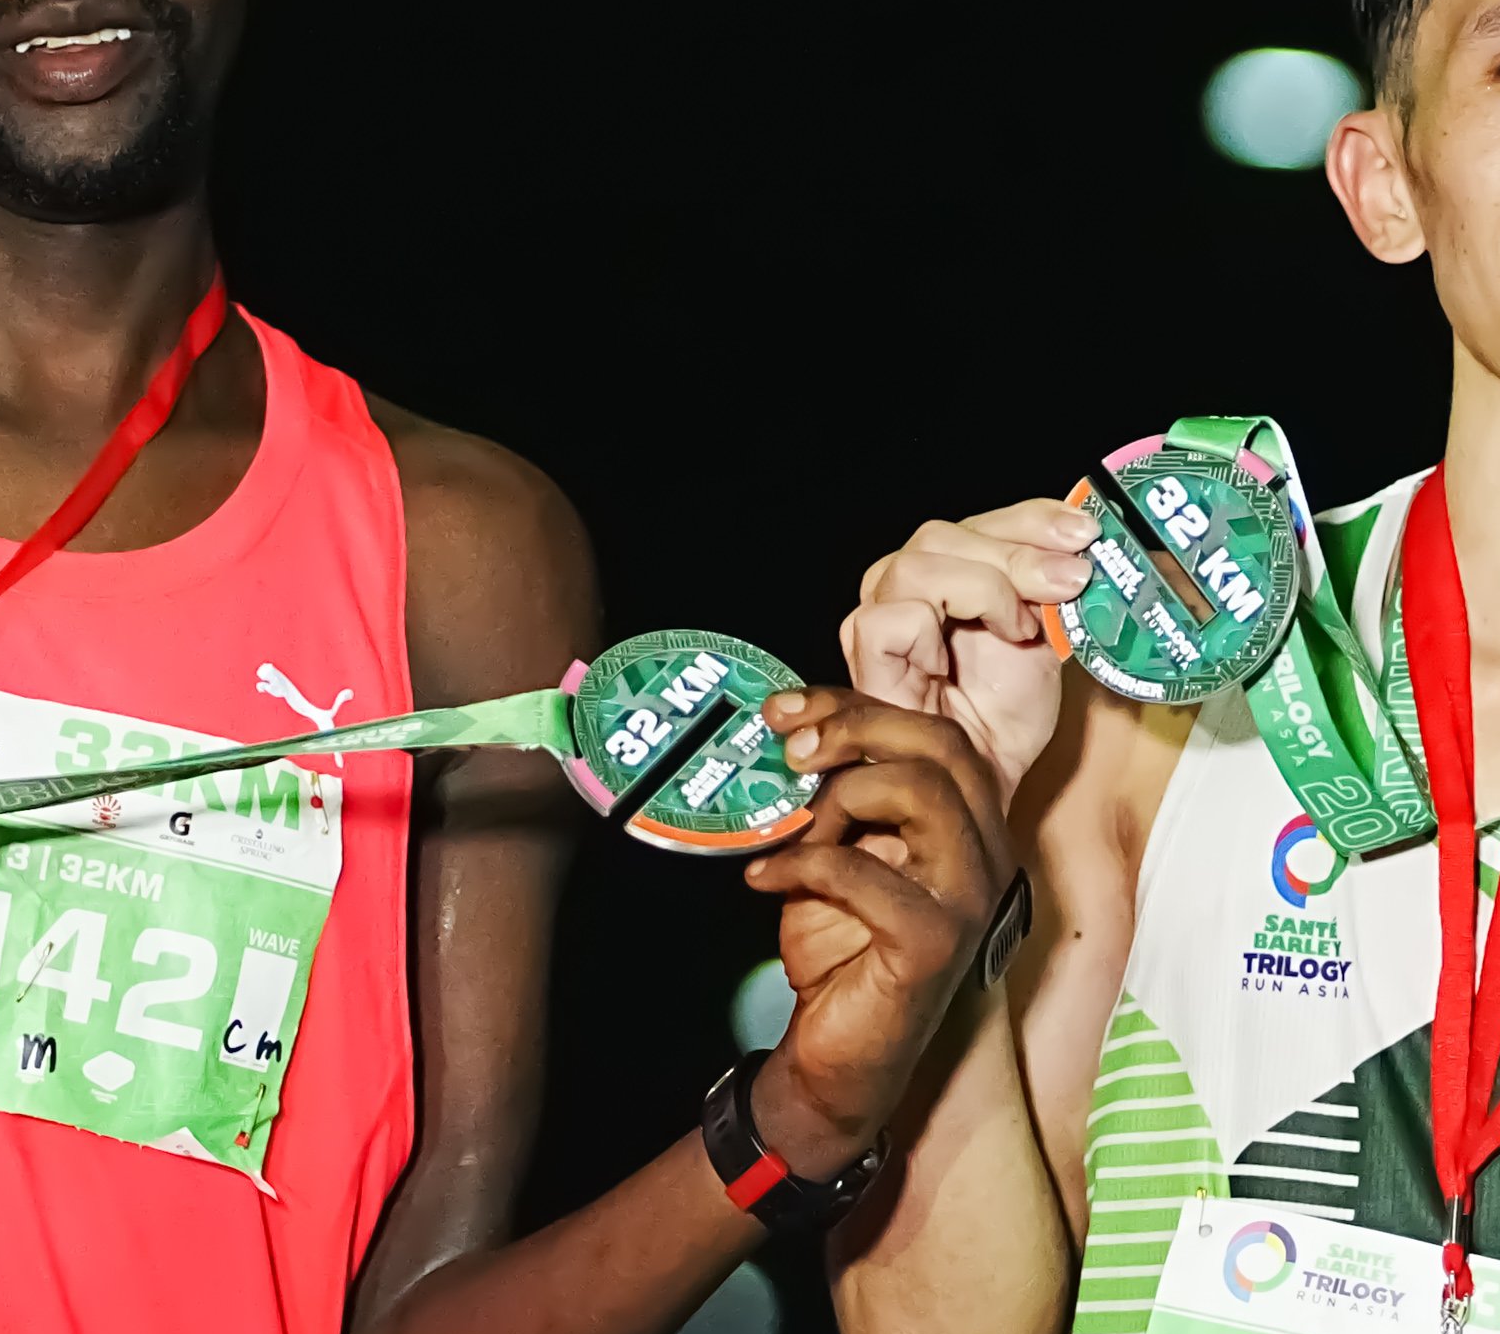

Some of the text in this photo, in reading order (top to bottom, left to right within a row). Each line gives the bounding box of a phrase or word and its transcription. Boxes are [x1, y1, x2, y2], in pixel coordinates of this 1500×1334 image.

[1146, 476, 1264, 623] 32 KM
[1142, 611, 1164, 637] RUN
[1151, 602, 1201, 663] TRILOGY
[1091, 656, 1166, 699] FINISHER
[605, 652, 729, 765] 32 KM
[1274, 646, 1333, 759] RILOGY
[7, 842, 31, 871] 3
[59, 854, 165, 903] 32KM
[248, 927, 301, 957] WAVE
[1264, 914, 1338, 939] SANTÉ
[1253, 932, 1341, 957] BARLEY
[1243, 952, 1353, 982] TRILOGY
[1241, 977, 1349, 999] RUN ASIA
[1296, 1290, 1400, 1322] RUN ASIA
[1303, 1270, 1406, 1308] TRILOGY
